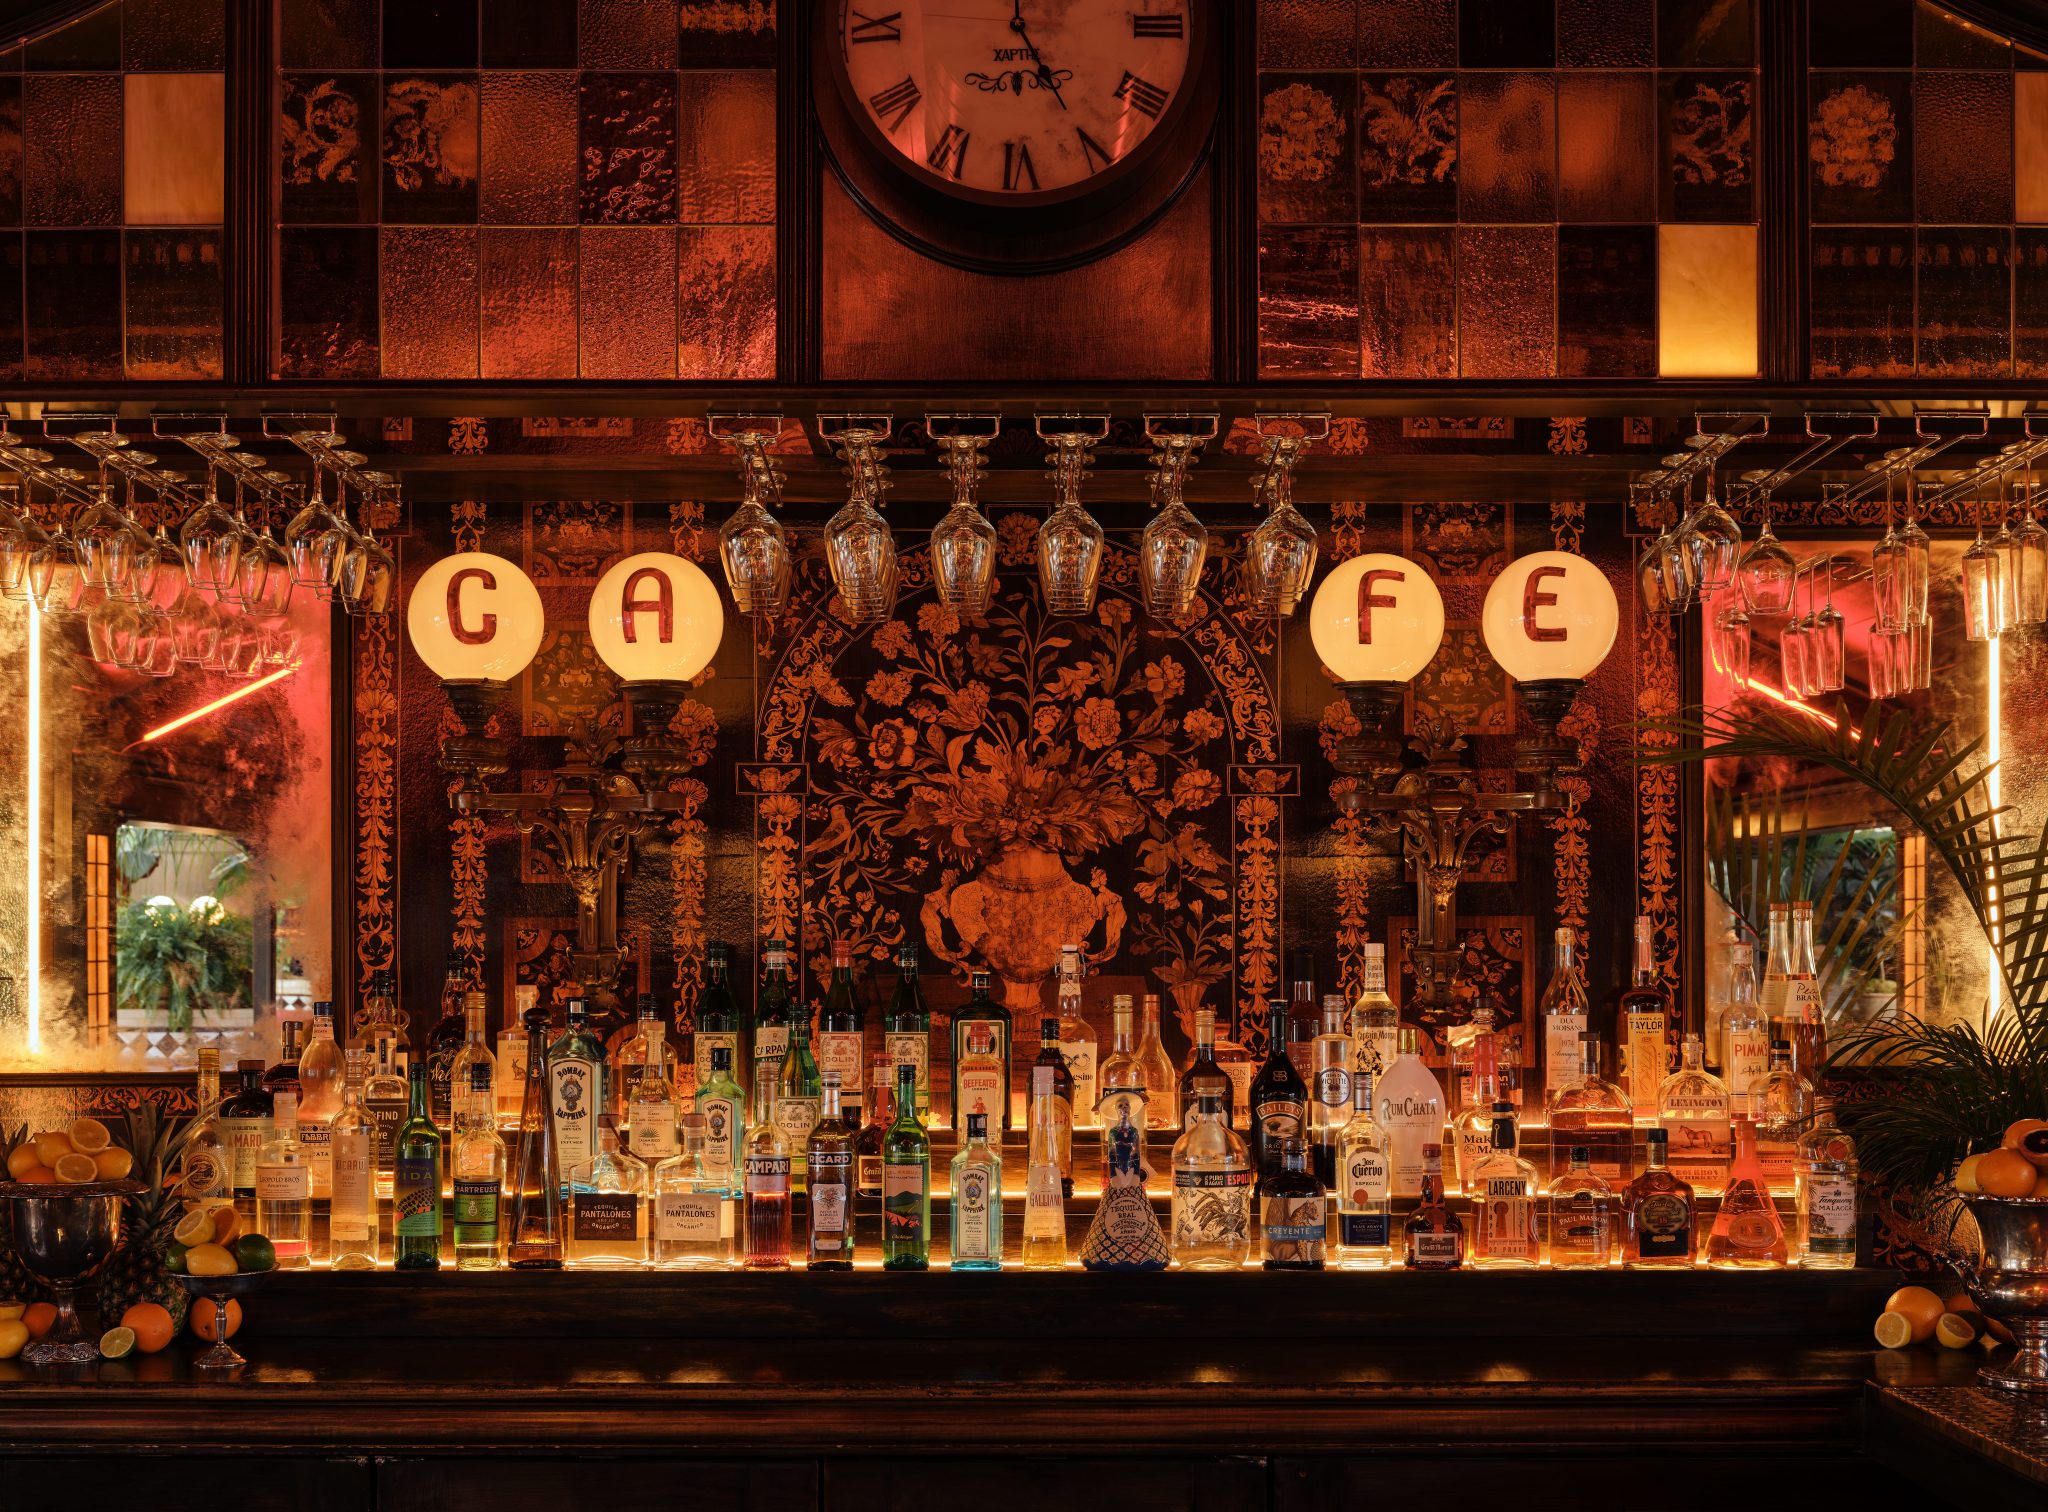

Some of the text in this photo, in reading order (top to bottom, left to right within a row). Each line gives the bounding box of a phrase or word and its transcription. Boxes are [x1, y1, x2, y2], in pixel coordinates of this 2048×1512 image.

[446, 566, 1568, 645] C A F E
[1796, 982, 1820, 995] Pea
[1629, 1021, 1663, 1030] TAYLOR
[1357, 1030, 1377, 1042] Captain
[557, 1066, 586, 1080] BOMBAY
[963, 1078, 997, 1090] BEEFEATER
[1670, 1099, 1723, 1107] LEXINGTON
[555, 1106, 589, 1120] SAPPHIRE
[1260, 1103, 1301, 1116] BAILEYS
[375, 1111, 399, 1120] FIND
[1464, 1134, 1492, 1144] Mak
[1477, 1145, 1493, 1154] Ma
[809, 1155, 850, 1164] RICARD
[744, 1159, 790, 1174] CAMPARI
[1351, 1163, 1383, 1178] Cuervo
[962, 1172, 985, 1183] BOMBAY
[454, 1185, 498, 1193] CHARTREUSE
[1488, 1180, 1526, 1196] LARCENY
[1029, 1191, 1062, 1208] GALLIANO
[961, 1203, 986, 1213] SAPPHIRE
[1110, 1204, 1142, 1212] TEQUILA
[580, 1210, 632, 1218] PANTALONES
[665, 1210, 716, 1218] PANTALONES
[1558, 1215, 1608, 1225] PAUL MASSON
[1268, 1227, 1310, 1235] CREYENTE
